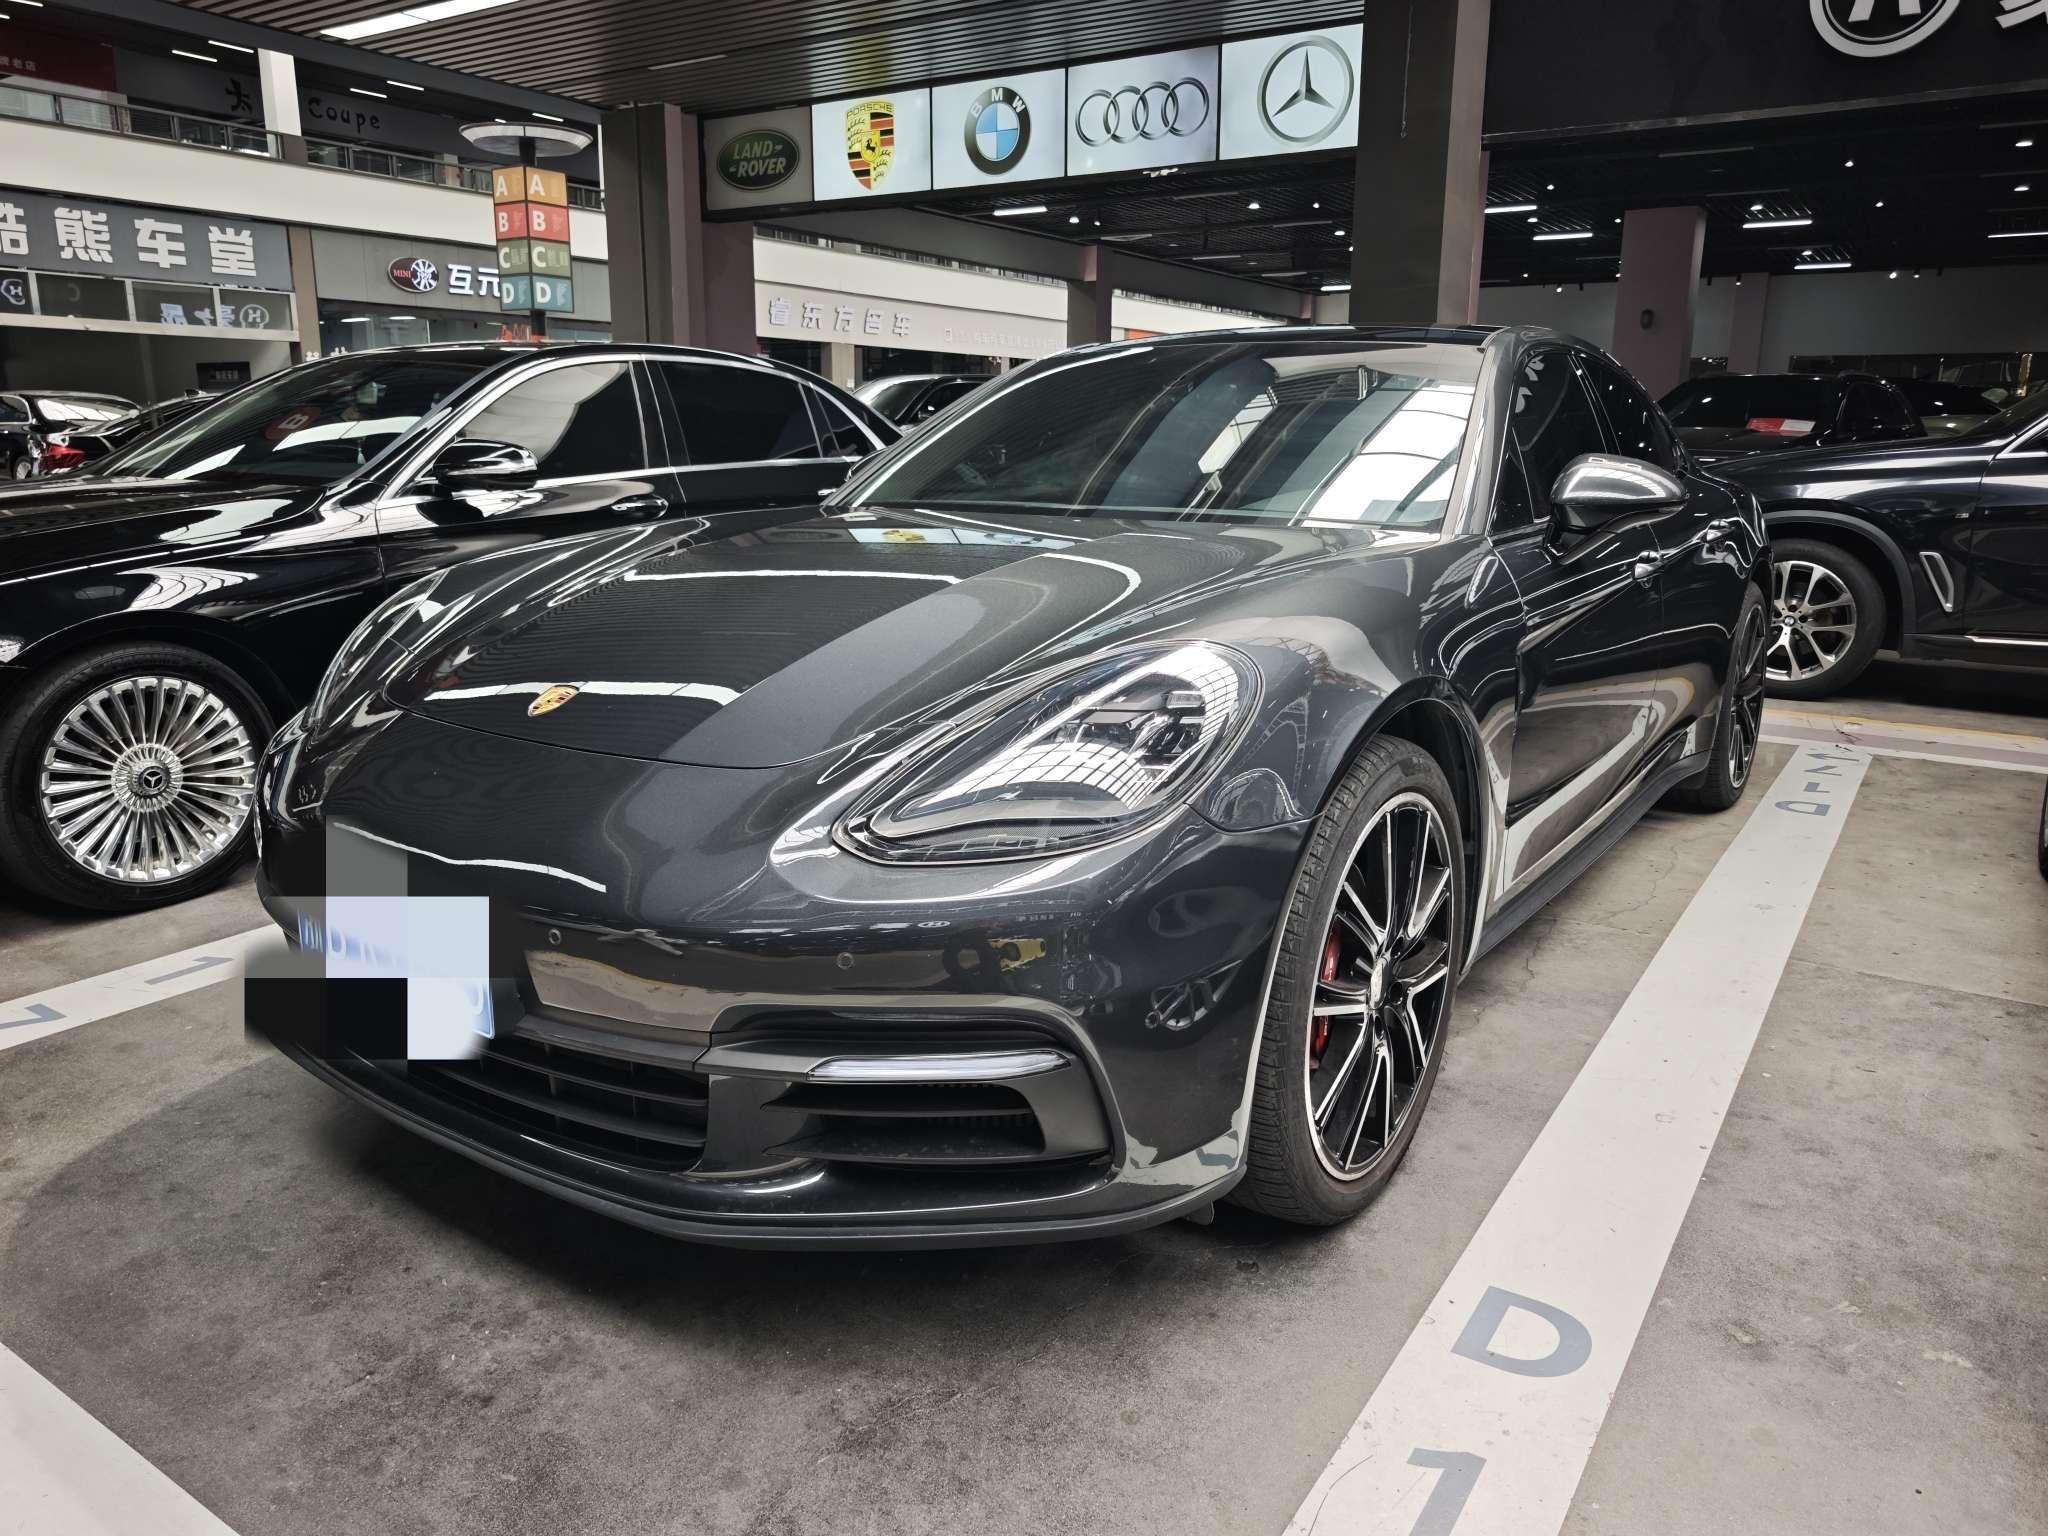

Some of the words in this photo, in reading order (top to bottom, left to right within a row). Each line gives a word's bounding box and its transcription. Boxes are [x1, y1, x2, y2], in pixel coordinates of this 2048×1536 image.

[846, 103, 894, 118] PORSCHE
[970, 87, 1026, 117] BMW
[307, 96, 381, 133] Coupe
[733, 140, 773, 160] LAND
[737, 157, 786, 178] ROVER
[496, 175, 508, 197] A
[529, 174, 546, 197] A
[498, 211, 509, 233] B
[532, 209, 545, 232] B
[499, 246, 511, 269] C
[533, 246, 546, 267] C
[393, 269, 411, 278] MINI
[502, 282, 514, 304] D
[536, 281, 552, 304] D
